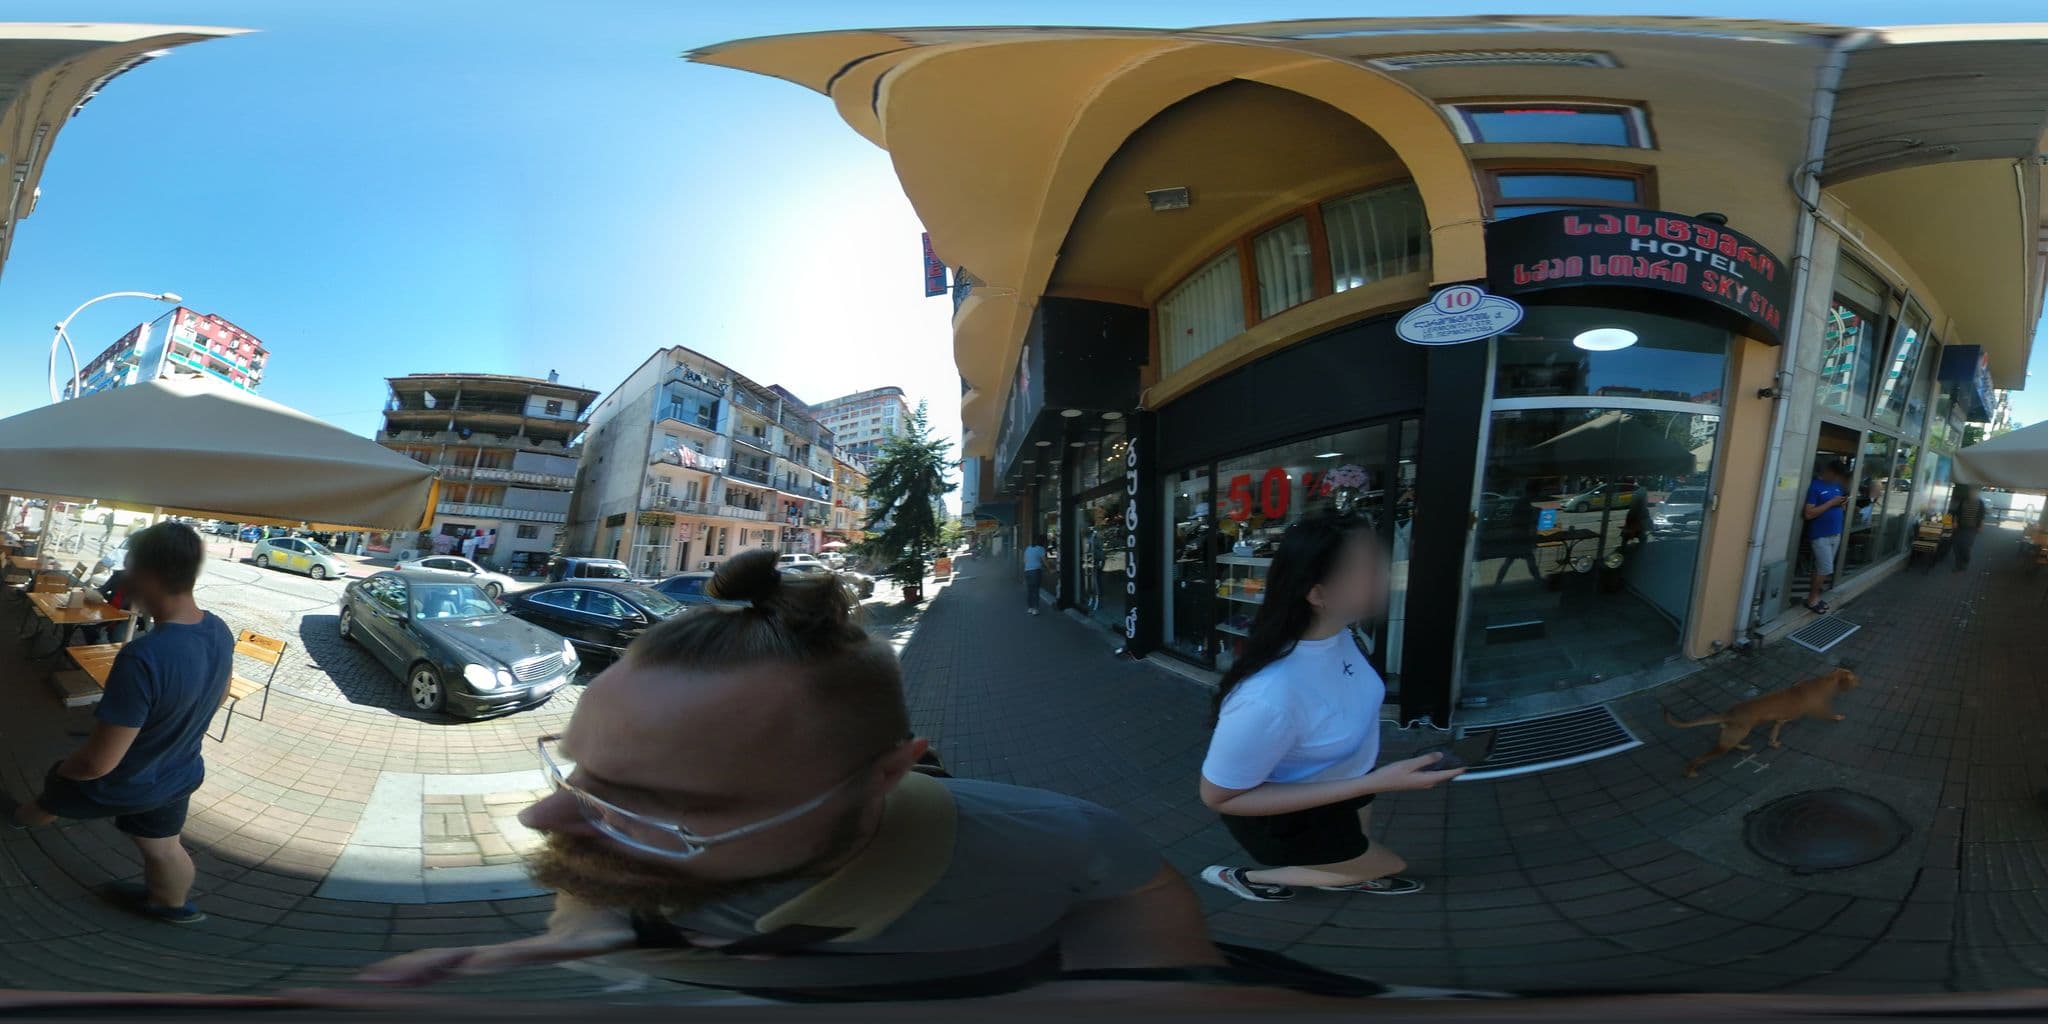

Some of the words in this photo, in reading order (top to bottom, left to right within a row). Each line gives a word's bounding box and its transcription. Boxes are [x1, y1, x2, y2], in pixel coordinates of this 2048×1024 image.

[1631, 238, 1744, 279] HOTEL
[1444, 292, 1473, 309] 10
[1701, 269, 1749, 304] SKY
[1749, 290, 1780, 330] STAR
